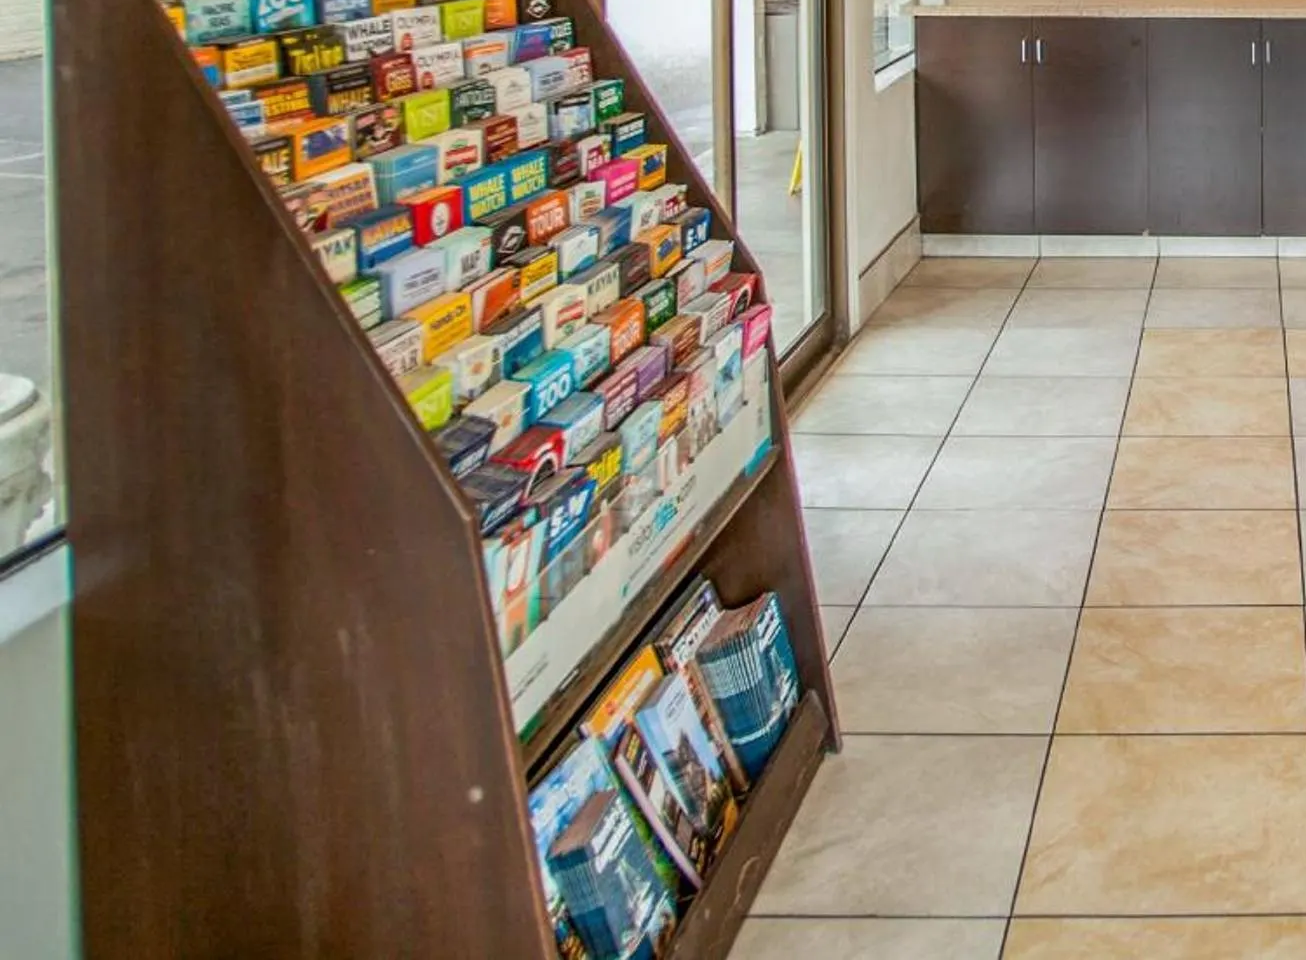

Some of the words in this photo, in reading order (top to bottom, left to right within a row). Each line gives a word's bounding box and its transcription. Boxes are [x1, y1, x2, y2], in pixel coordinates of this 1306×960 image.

[350, 18, 391, 39] WHALE
[511, 157, 544, 182] WHALE
[470, 173, 505, 197] WHALE
[512, 177, 545, 200] WATCH
[471, 192, 505, 219] WATCH
[530, 206, 564, 236] TOUR
[537, 373, 571, 418] ZOO
